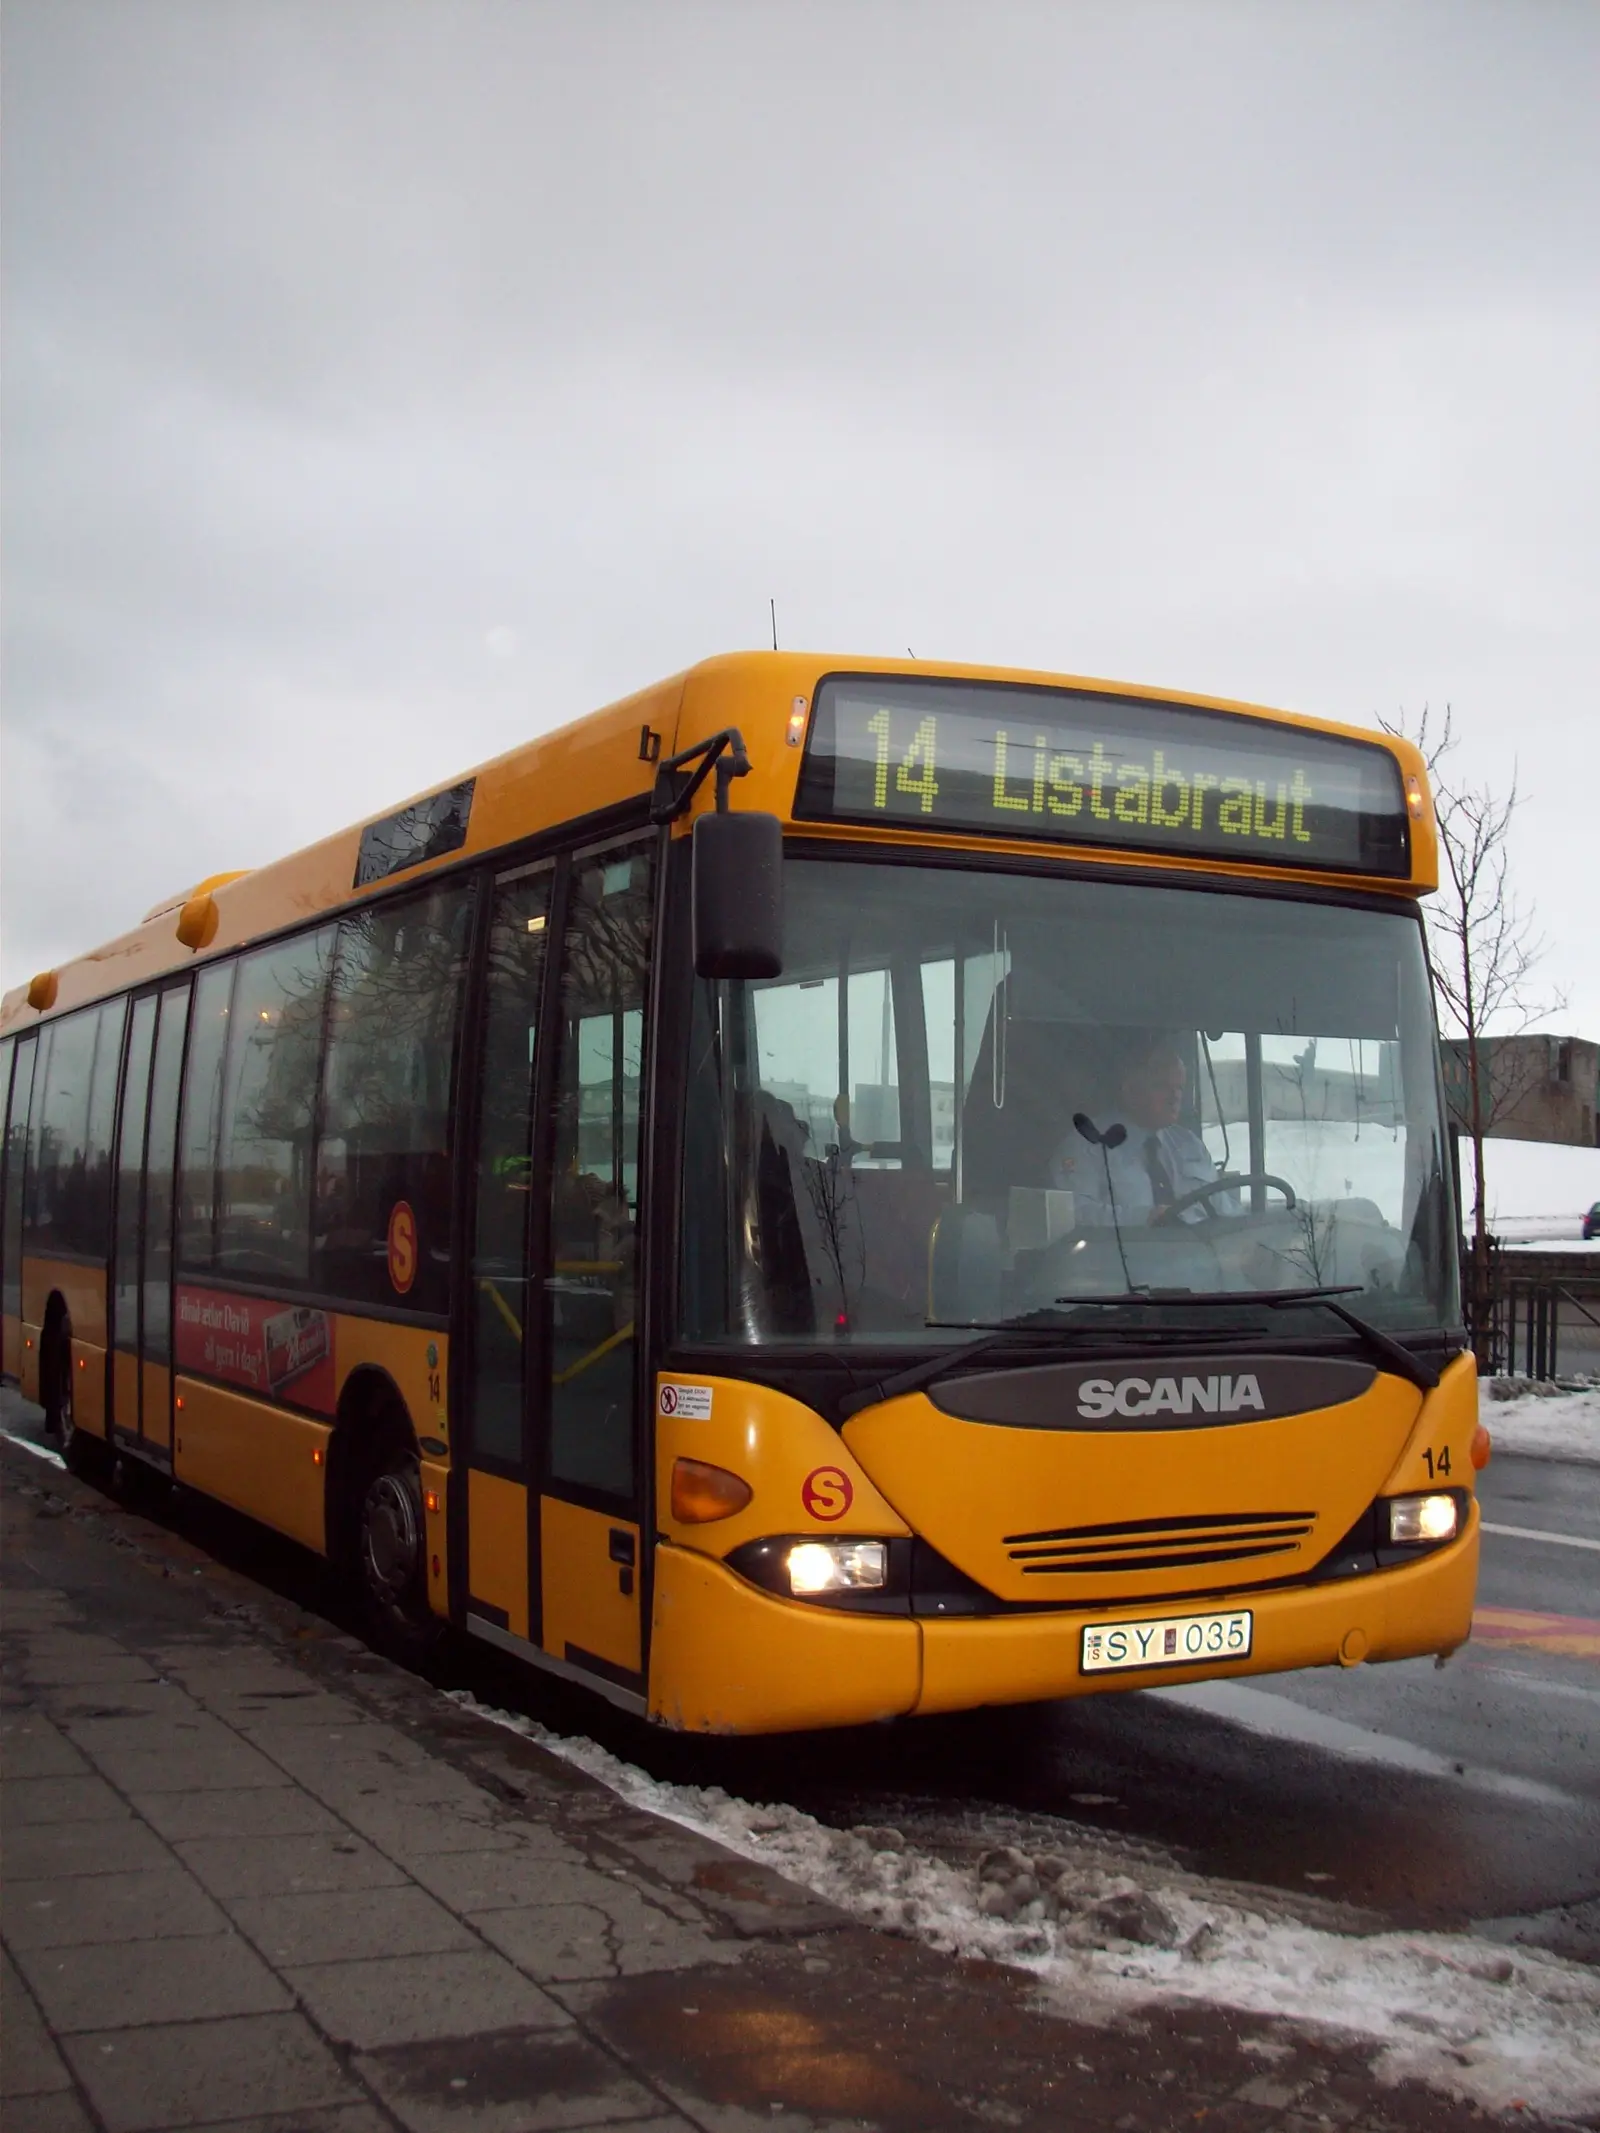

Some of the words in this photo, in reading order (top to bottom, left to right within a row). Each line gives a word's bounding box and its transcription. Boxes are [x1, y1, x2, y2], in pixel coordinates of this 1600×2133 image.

[867, 709, 939, 812] 14
[991, 731, 1312, 842] Listabraut
[428, 1373, 440, 1403] 14
[1076, 1374, 1265, 1418] SCANIA
[1422, 1445, 1451, 1479] 14
[1107, 1628, 1155, 1661] SY
[1186, 1620, 1243, 1653] 035
